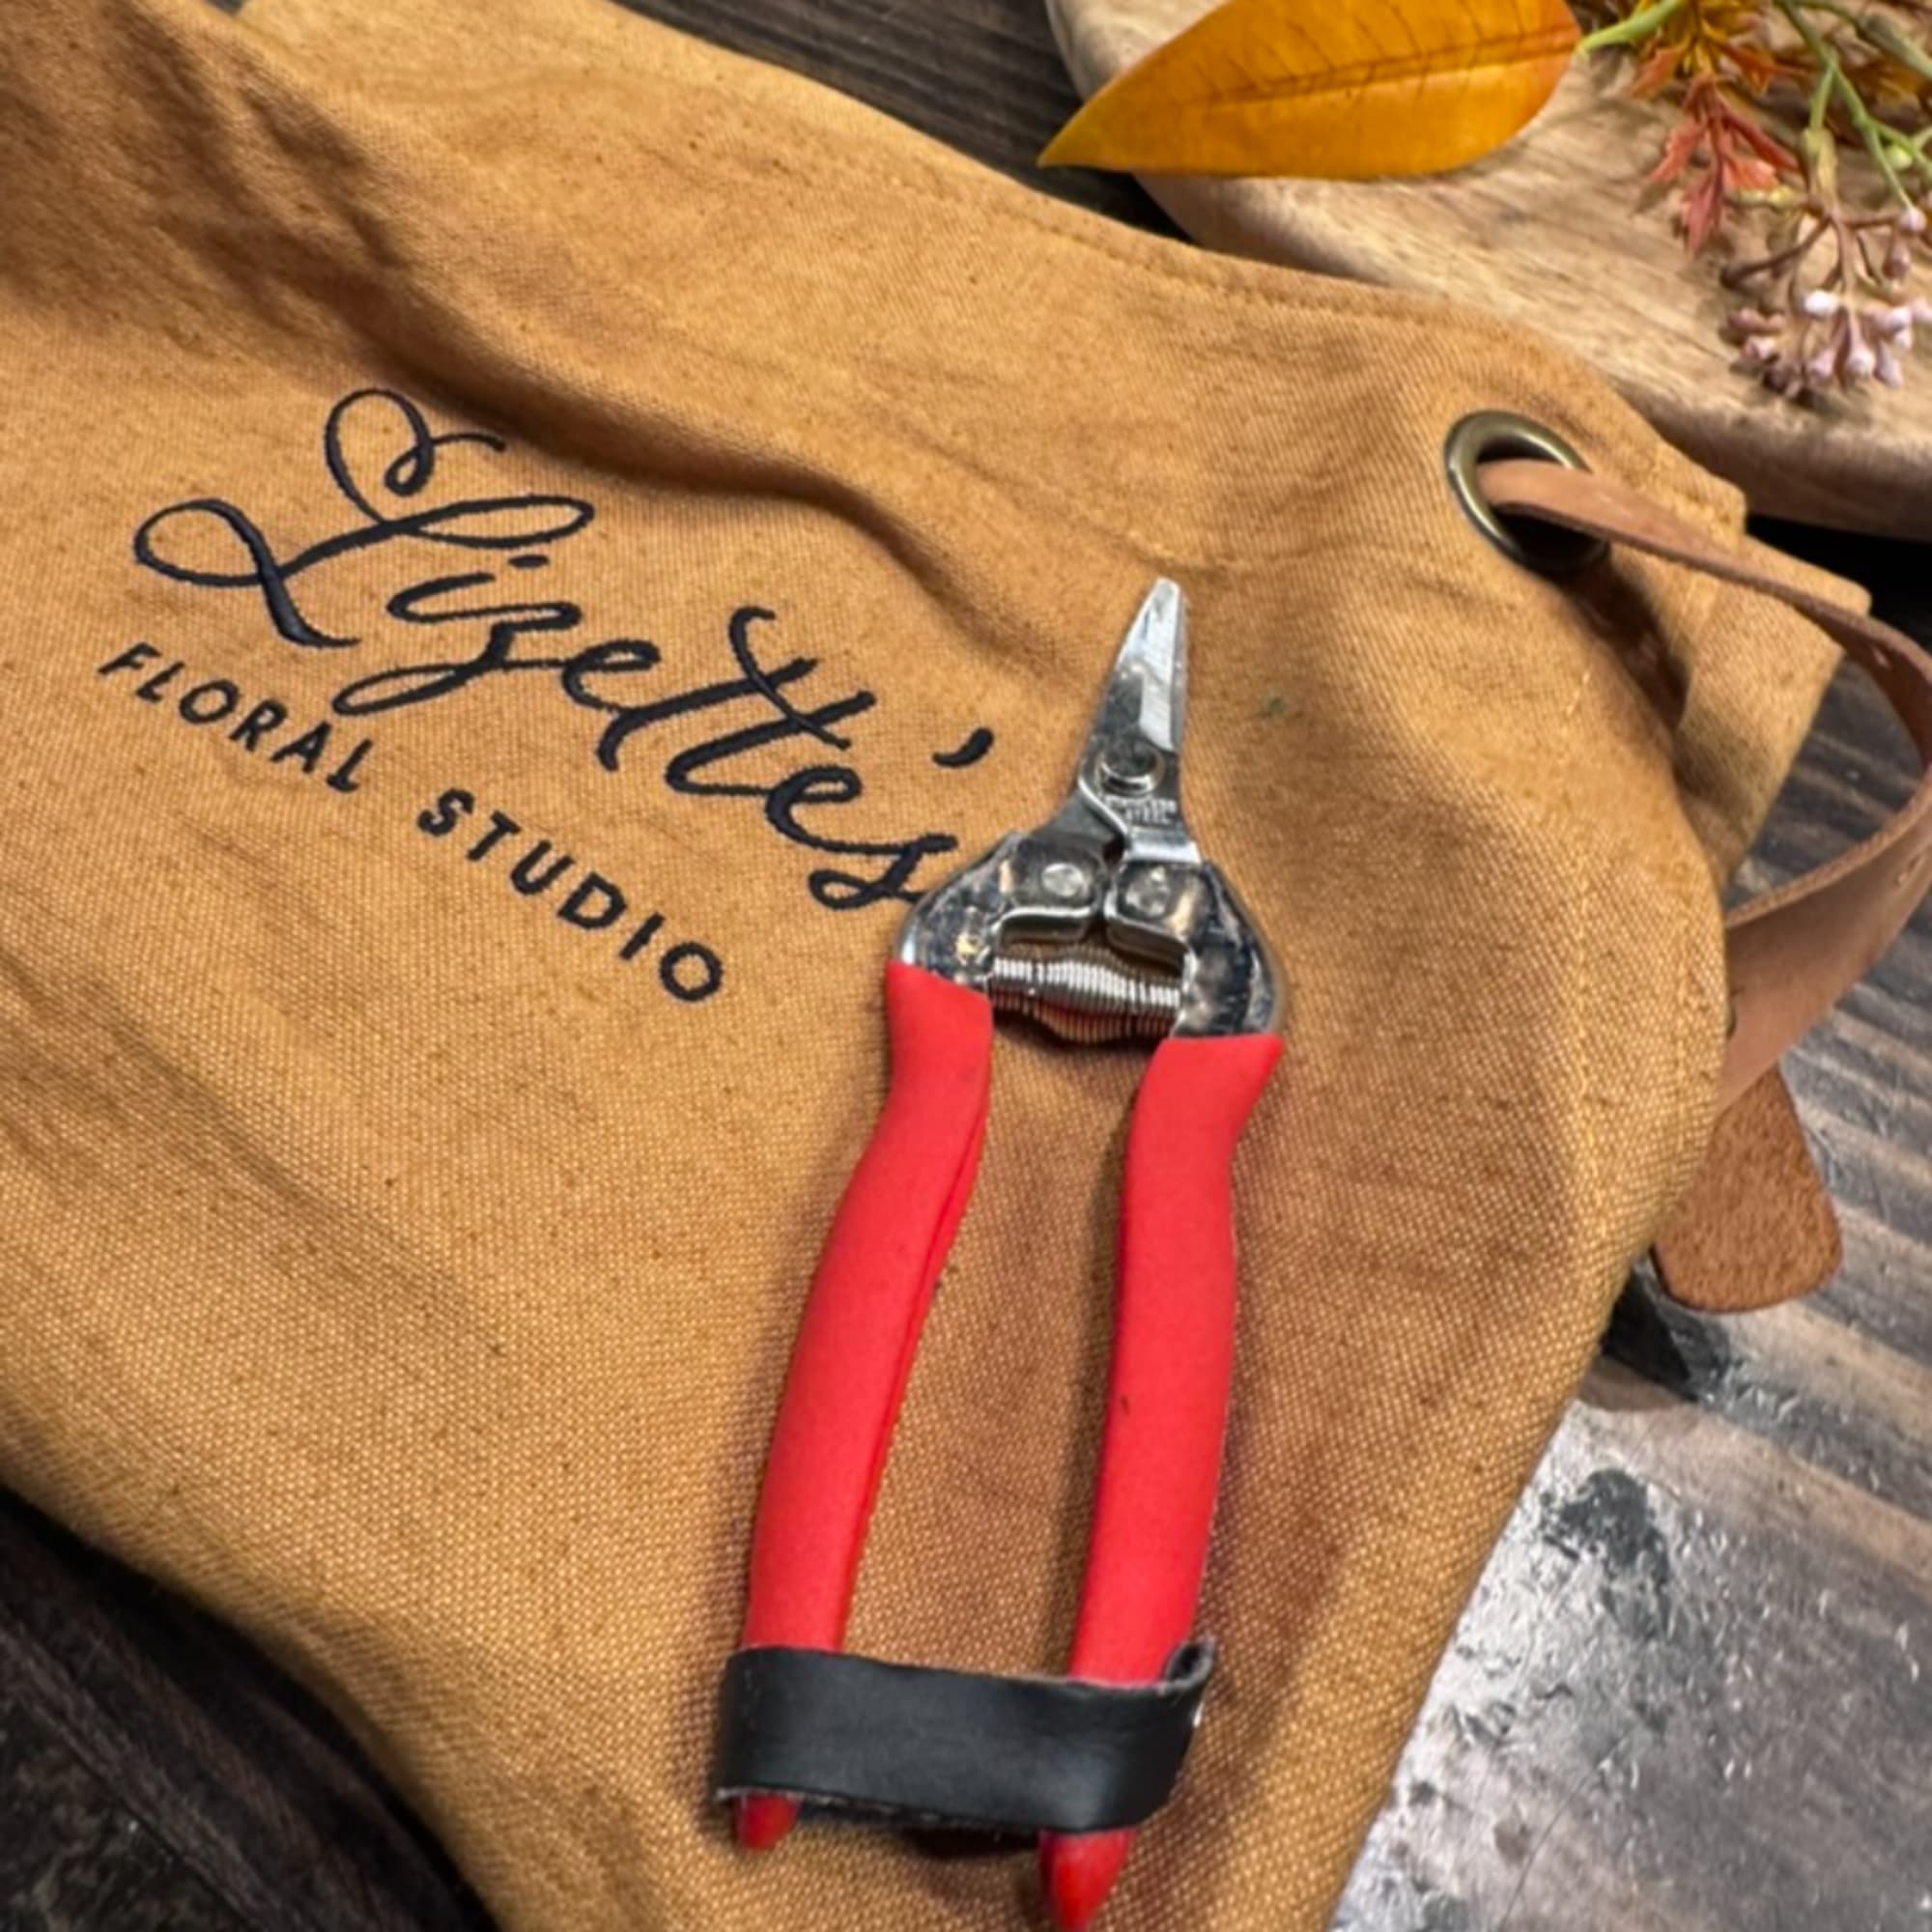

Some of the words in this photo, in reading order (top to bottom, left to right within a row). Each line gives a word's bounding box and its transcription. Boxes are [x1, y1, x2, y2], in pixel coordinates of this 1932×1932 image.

[99, 642, 380, 793] FLORAL
[416, 788, 724, 1002] STUDIO
[133, 388, 995, 910] Lizette's
